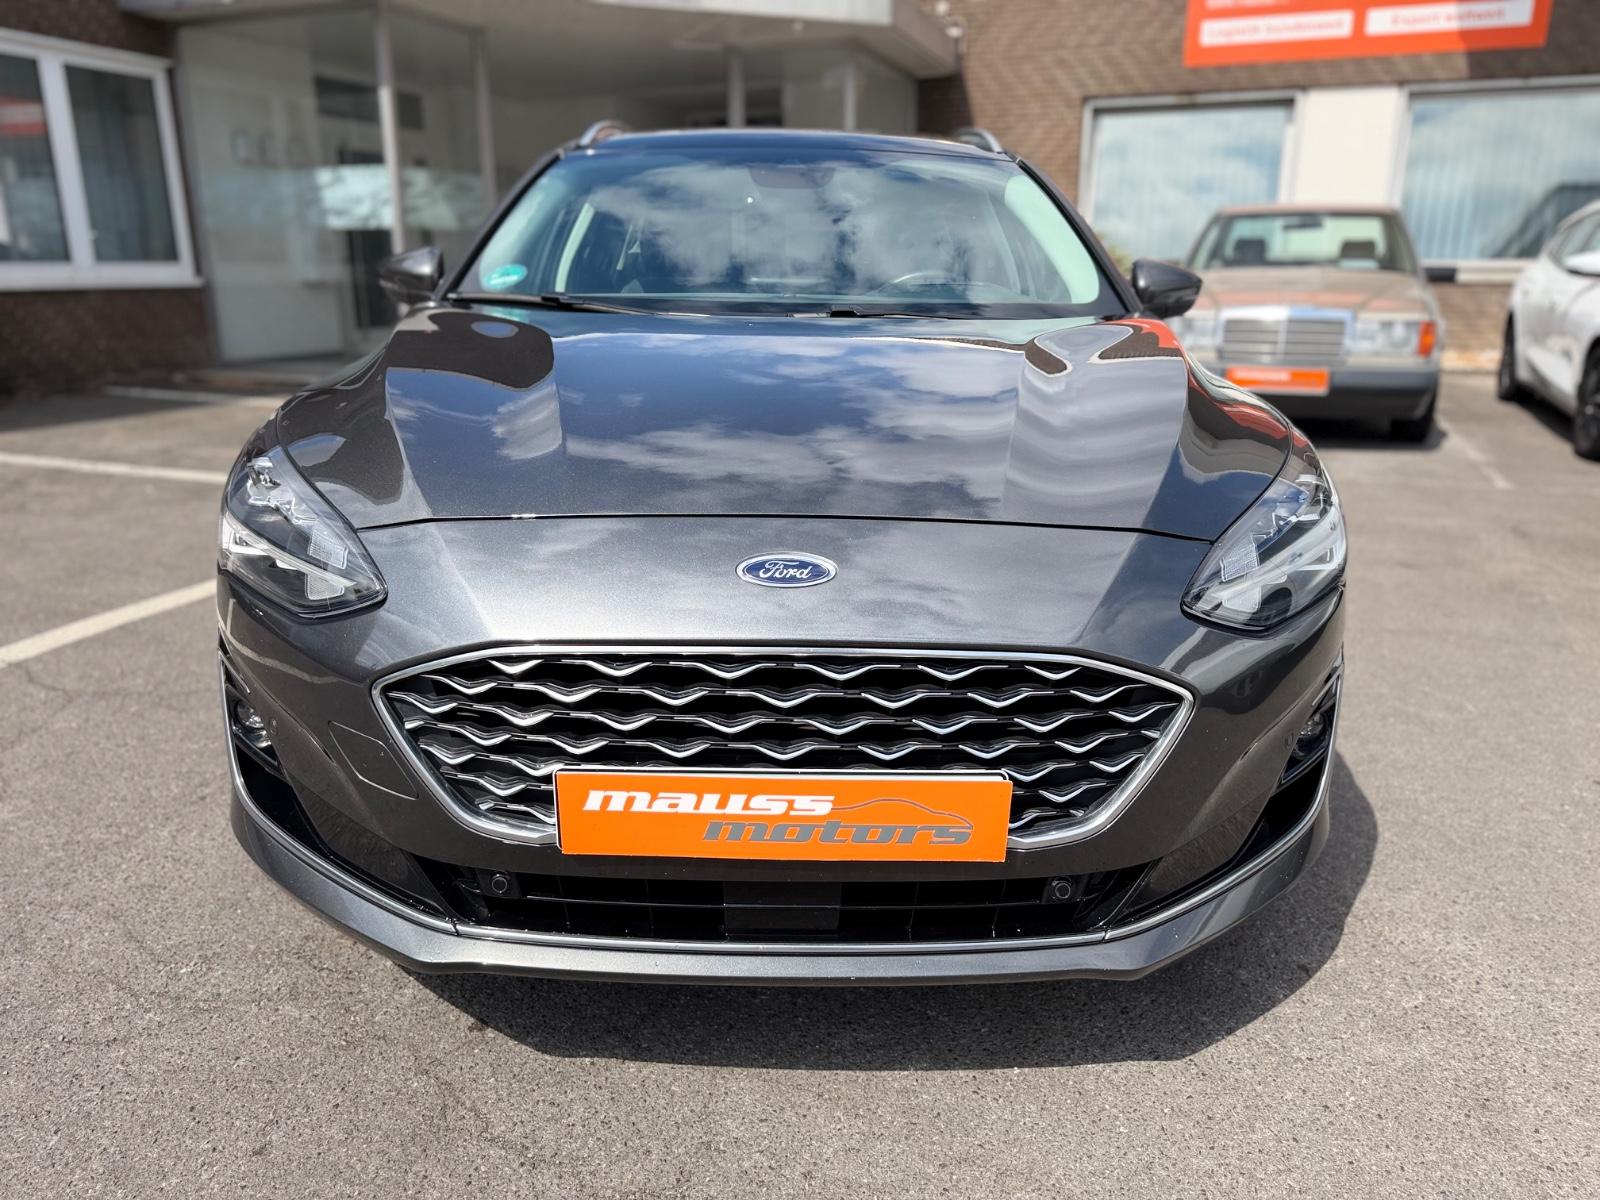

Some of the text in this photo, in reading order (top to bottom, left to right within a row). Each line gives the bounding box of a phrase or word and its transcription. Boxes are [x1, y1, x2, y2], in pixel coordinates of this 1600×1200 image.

[759, 561, 813, 579] Ford
[583, 789, 835, 816] mauss
[702, 820, 973, 845] motors
